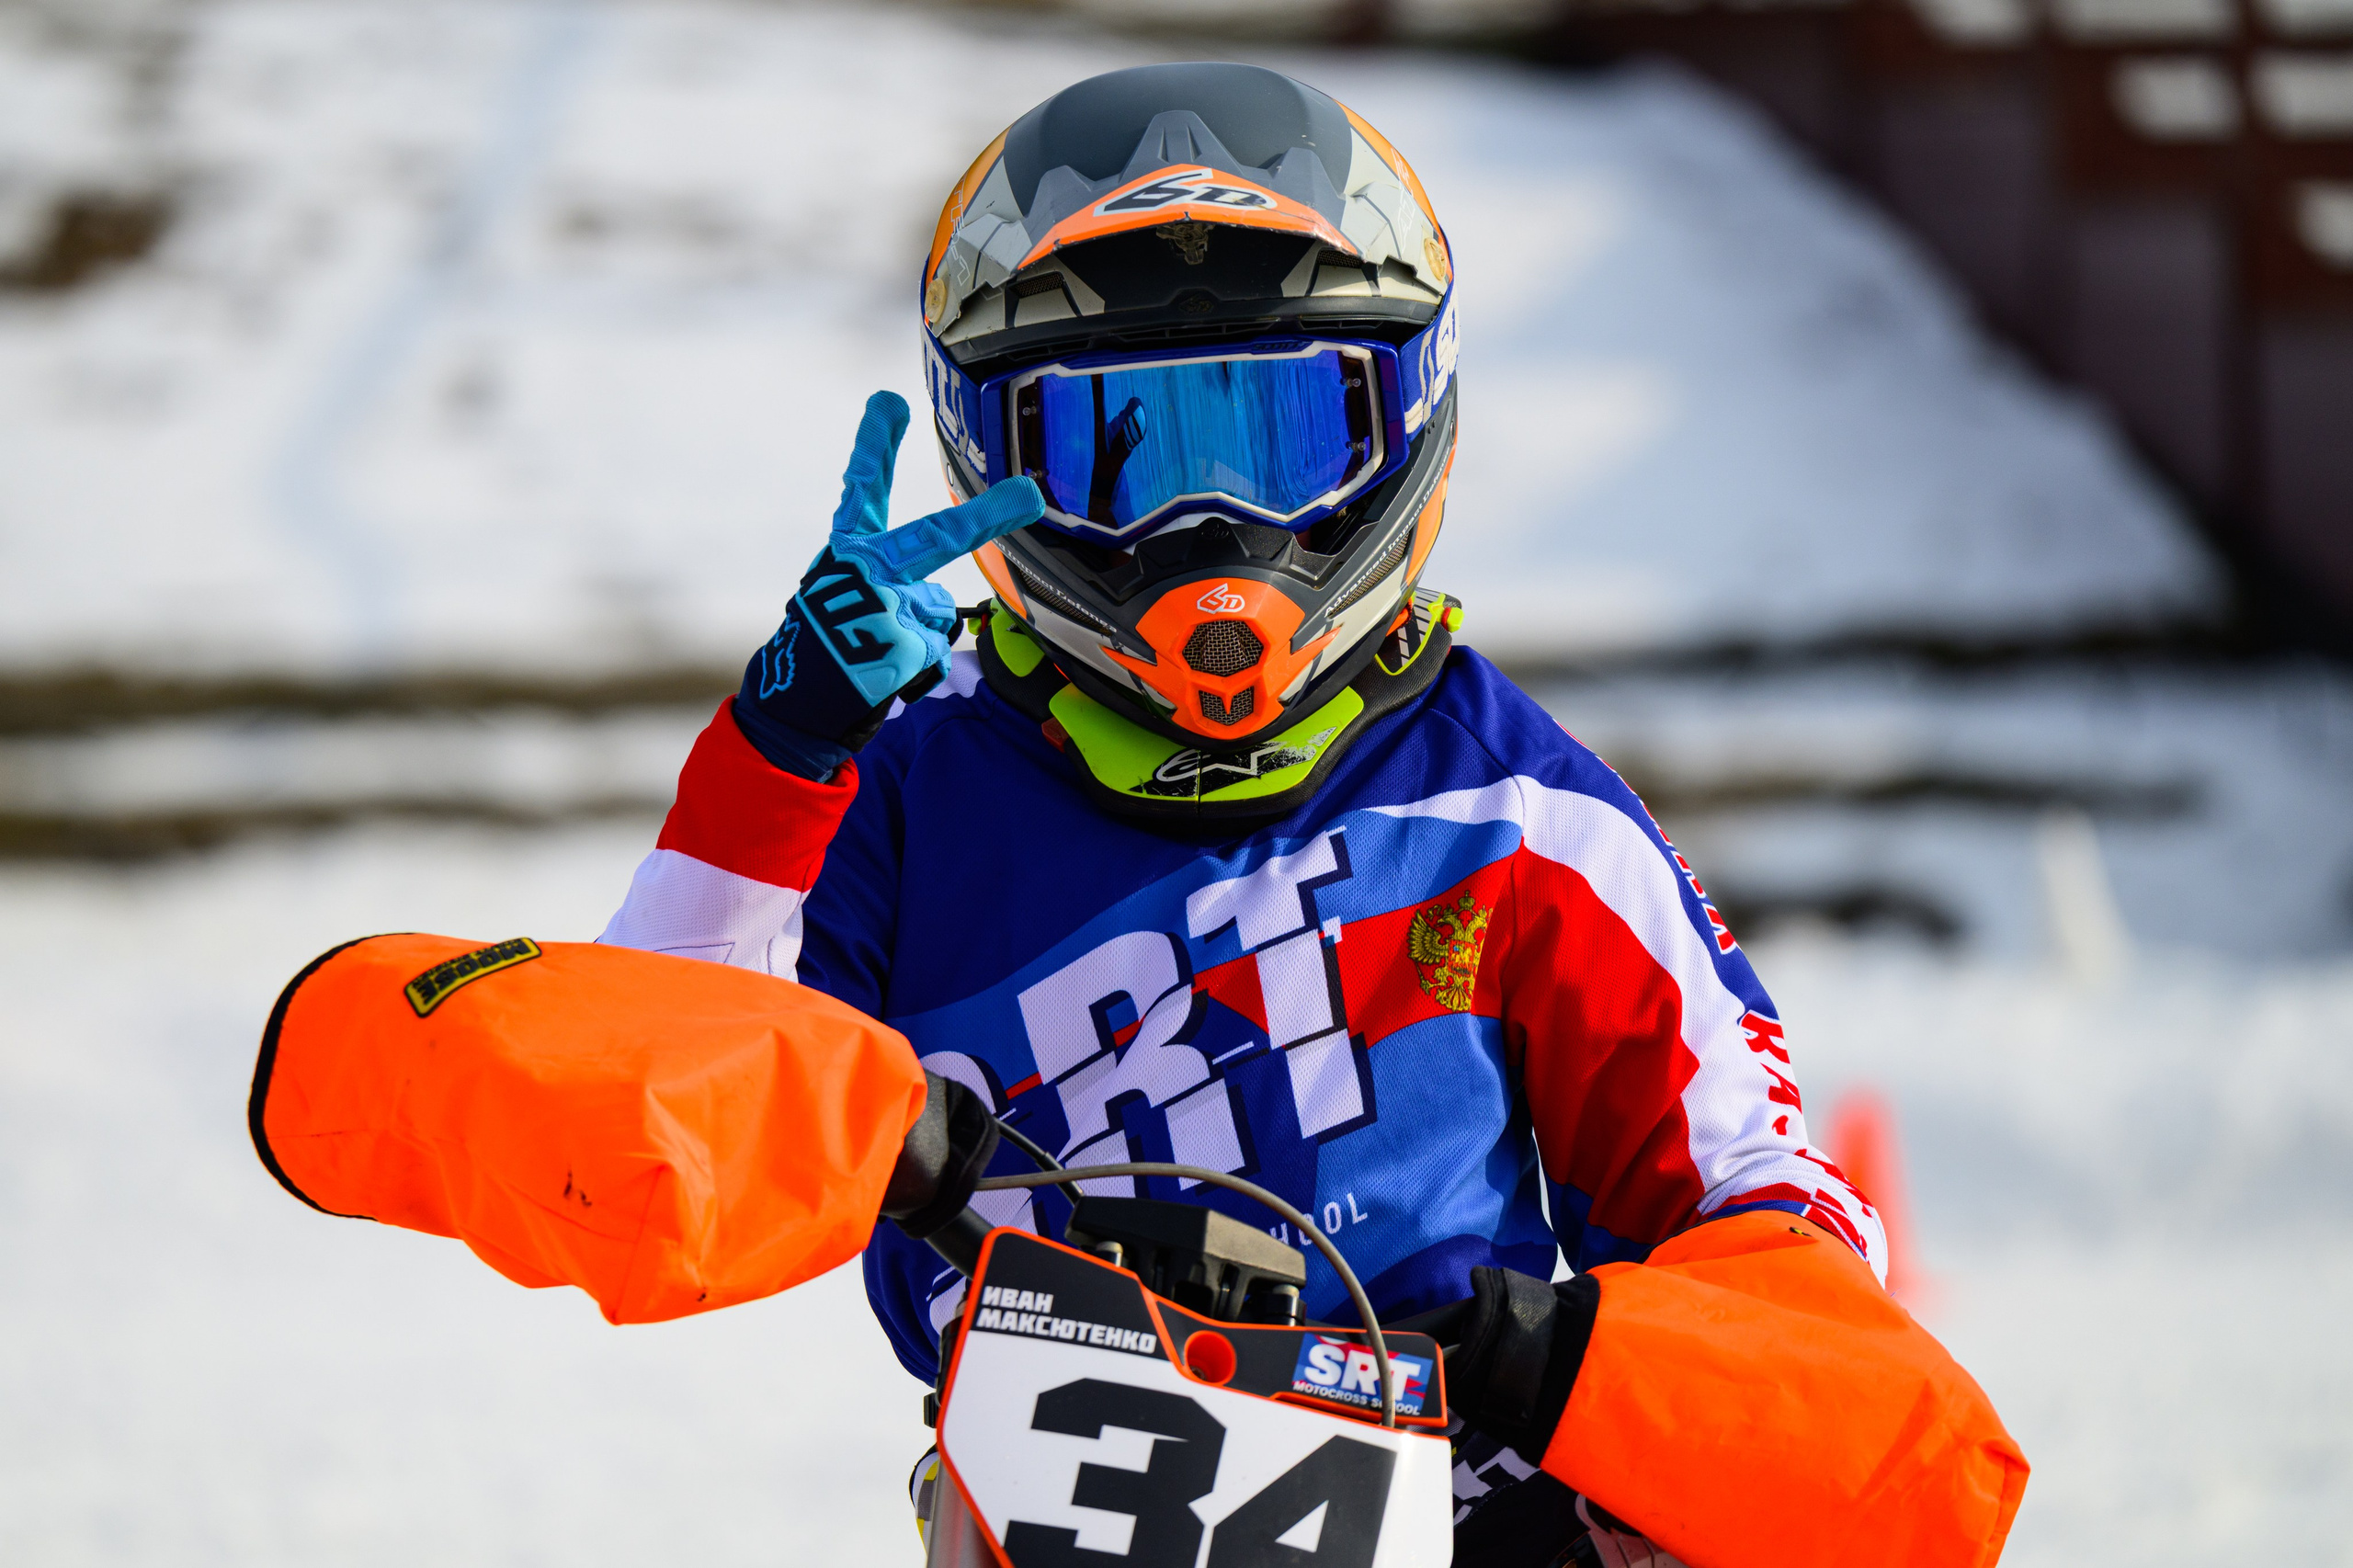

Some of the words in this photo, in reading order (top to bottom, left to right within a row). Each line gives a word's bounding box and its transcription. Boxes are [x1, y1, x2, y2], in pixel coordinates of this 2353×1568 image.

[1007, 550, 1054, 592] Impact
[1324, 551, 1387, 619] Advanced
[1387, 502, 1425, 552] Impact
[1197, 583, 1245, 614] 6D
[981, 1285, 1054, 1314] ИВАН
[976, 1307, 1158, 1354] МАКСЮТЕНКО
[1292, 1380, 1369, 1405] MOTOCROSS
[1303, 1343, 1422, 1402] SRT
[1005, 1377, 1399, 1568] 34
